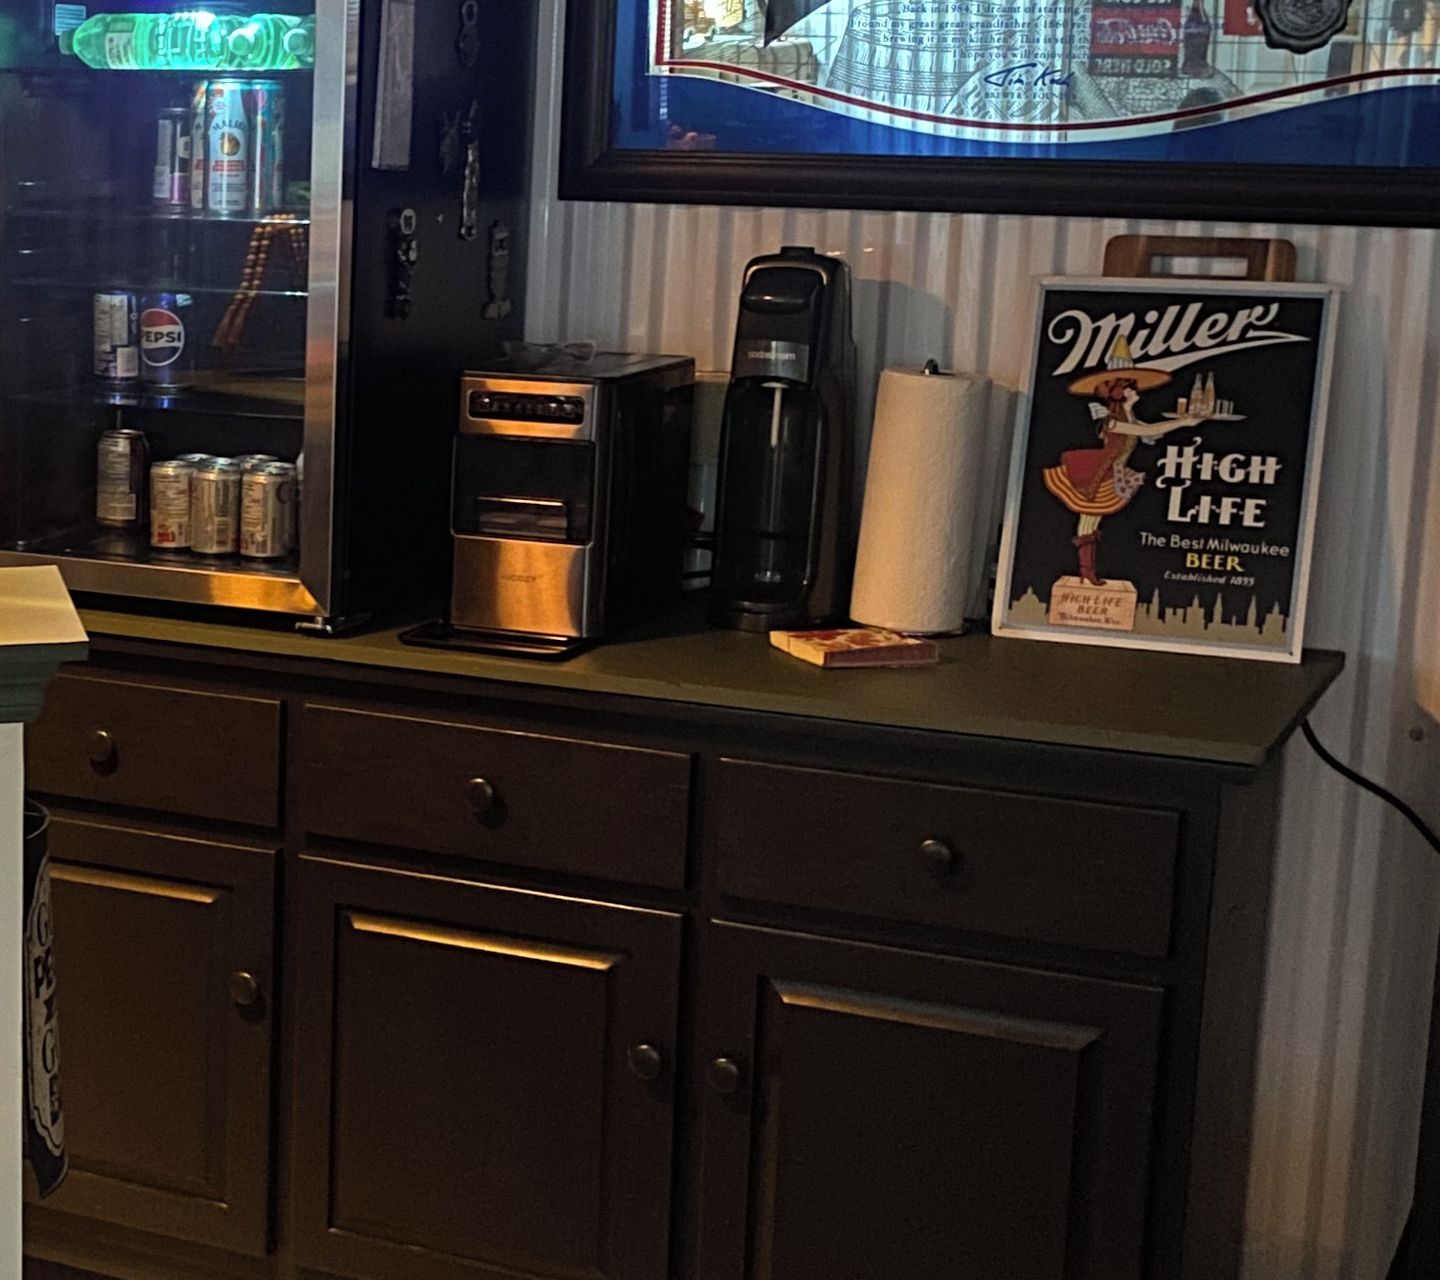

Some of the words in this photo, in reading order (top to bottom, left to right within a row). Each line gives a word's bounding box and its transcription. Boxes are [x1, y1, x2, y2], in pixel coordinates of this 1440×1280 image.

[858, 19, 888, 28] found
[909, 21, 934, 30] great
[938, 21, 965, 30] great
[883, 34, 924, 45] brewing
[1047, 302, 1305, 377] Miller
[1156, 436, 1283, 486] HIGH
[1157, 479, 1268, 528] LIFE
[1140, 532, 1167, 548] The
[1170, 534, 1205, 550] Best
[1206, 538, 1290, 557] Milwaukee
[1186, 553, 1245, 572] BEER
[1164, 571, 1226, 584] Established
[1077, 605, 1109, 616] BEER
